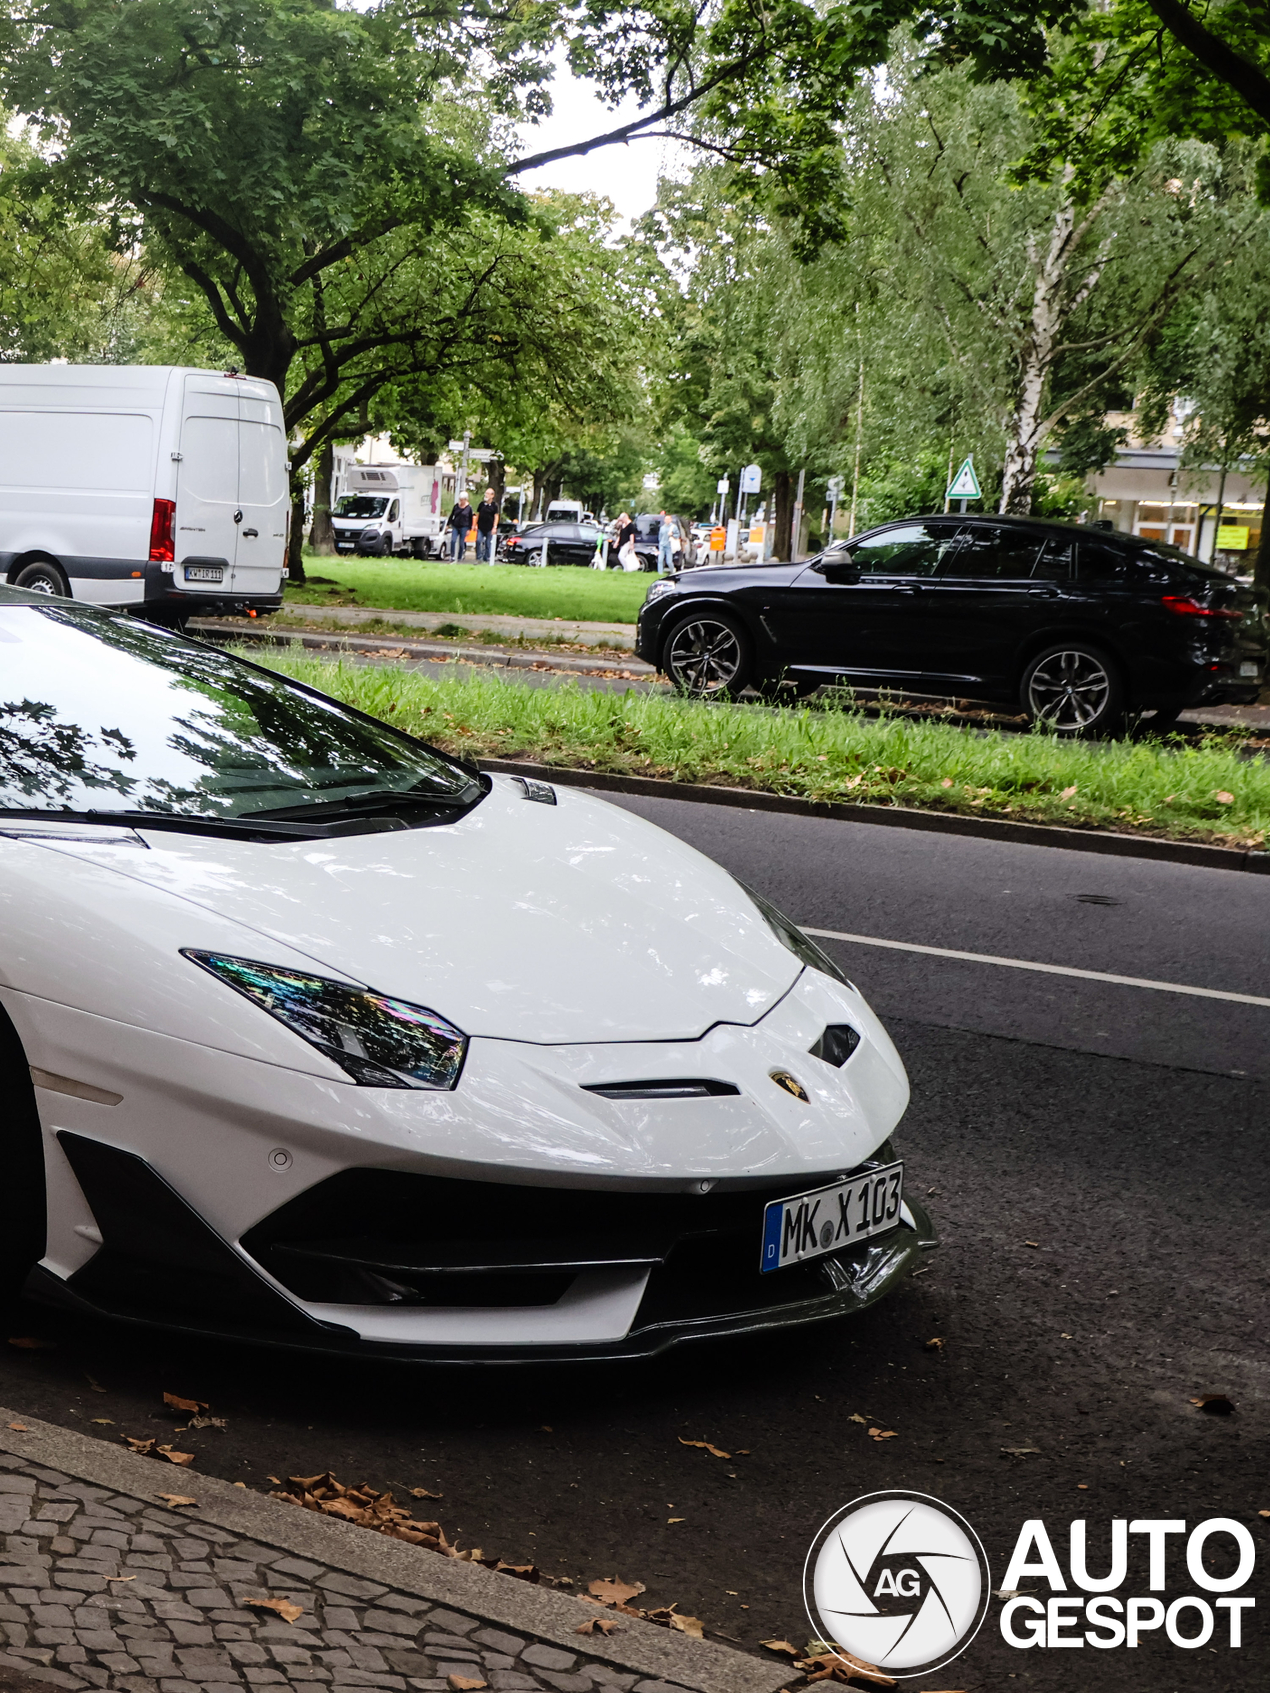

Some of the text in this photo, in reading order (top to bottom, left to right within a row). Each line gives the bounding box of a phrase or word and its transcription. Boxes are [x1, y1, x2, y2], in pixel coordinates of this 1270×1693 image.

[189, 568, 198, 578] KW
[211, 570, 222, 579] 111
[767, 1171, 901, 1259] D MK X 103
